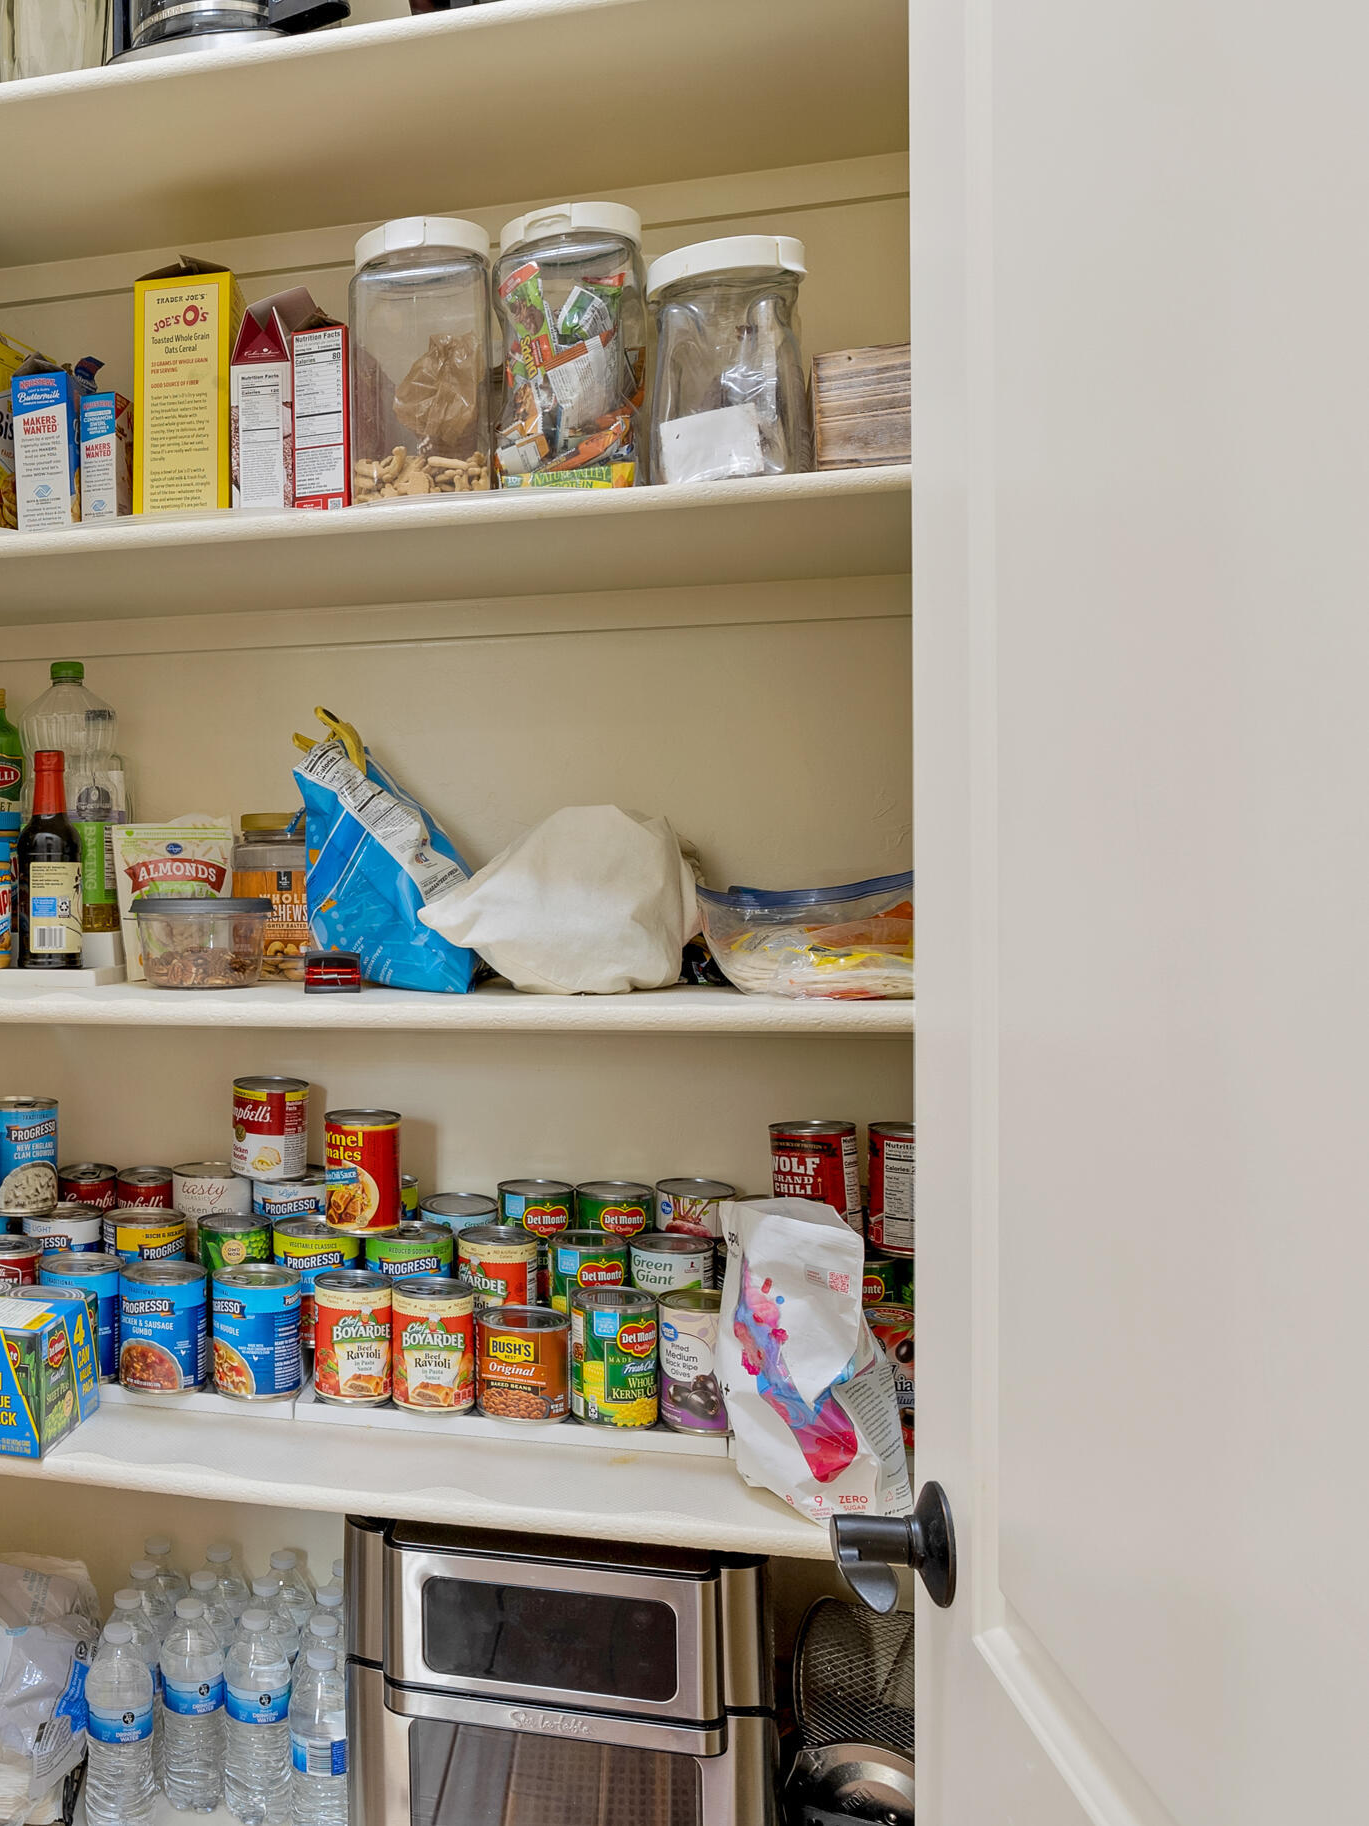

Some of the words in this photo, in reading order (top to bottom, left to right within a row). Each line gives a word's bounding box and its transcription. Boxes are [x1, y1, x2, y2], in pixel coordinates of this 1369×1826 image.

[156, 296, 183, 304] TRADER
[185, 293, 206, 301] JOE'S
[153, 314, 181, 332] JOE'S
[183, 304, 209, 327] O's
[151, 335, 174, 344] Toasted
[175, 334, 193, 342] Whole
[193, 332, 210, 341] Grain
[295, 333, 322, 343] Nutrition
[323, 331, 341, 339] Facts
[164, 346, 178, 354] Oats
[179, 344, 198, 353] Cereal
[17, 389, 61, 403] Buttermilk
[23, 415, 57, 427] MAKERS
[23, 424, 57, 436] WANTED
[85, 443, 111, 452] MAKERS
[85, 450, 111, 459] WANTED
[534, 467, 570, 486] NATURE
[571, 466, 611, 483] VALLEY
[84, 824, 98, 890] BAKING
[138, 861, 217, 883] ALMONDS
[11, 1120, 56, 1141] PROGRESSO
[16, 1144, 30, 1152] NEW
[13, 1151, 31, 1159] CLAM
[773, 1174, 814, 1184] BRAND
[181, 1181, 226, 1205] tasty
[775, 1183, 812, 1195] CHILI
[265, 1200, 317, 1216] PROGRESSO
[526, 1215, 541, 1225] Del
[542, 1213, 567, 1225] Monte
[603, 1215, 618, 1225] Del
[619, 1213, 644, 1225] Monte
[287, 1253, 341, 1270] PROGRESSO
[382, 1259, 438, 1276] PROGRESSO
[633, 1256, 673, 1272] Green
[581, 1271, 596, 1282] Del
[596, 1269, 622, 1282] Monte
[636, 1269, 675, 1287] Giant
[122, 1300, 170, 1313] PROGRESSO
[73, 1314, 85, 1346] 4
[132, 1327, 153, 1336] GUMBO
[144, 1320, 174, 1331] SAUSAGE
[332, 1321, 391, 1341] BOYARDEE
[407, 1322, 426, 1336] Chef
[402, 1330, 464, 1348] BOYARDEE
[621, 1332, 636, 1345] Del
[345, 1348, 382, 1361] Ravioli
[491, 1340, 531, 1356] BUSH'S
[77, 1346, 90, 1369] CAN
[424, 1352, 441, 1361] Beef
[665, 1348, 698, 1363] Medium
[414, 1356, 451, 1370] Ravioli
[489, 1362, 536, 1377] Original
[79, 1364, 93, 1383] VALUE
[82, 1378, 95, 1396] PACK
[490, 1382, 510, 1390] BAKED
[511, 1384, 532, 1392] BEANS
[627, 1376, 656, 1388] WHOLE
[612, 1385, 647, 1399] KERNEL
[838, 1495, 869, 1504] ZERO
